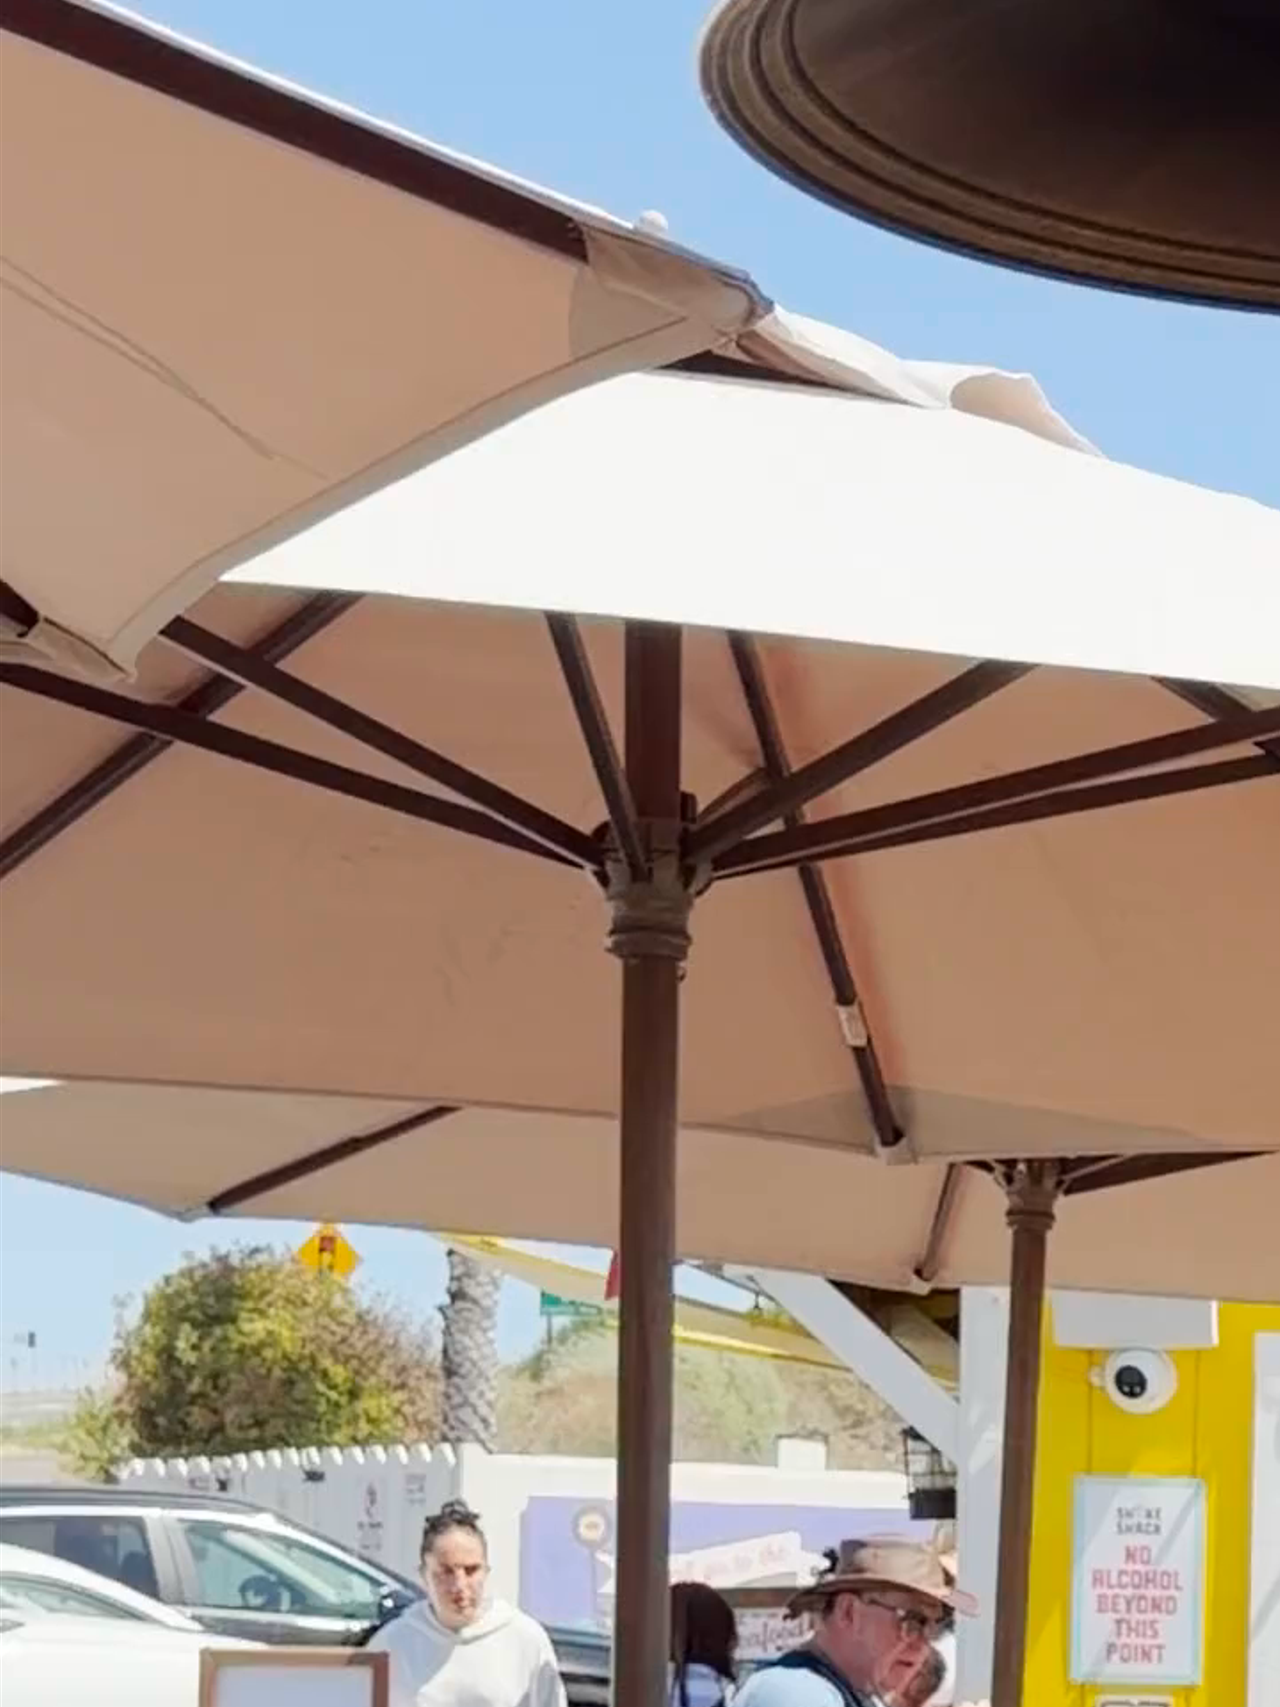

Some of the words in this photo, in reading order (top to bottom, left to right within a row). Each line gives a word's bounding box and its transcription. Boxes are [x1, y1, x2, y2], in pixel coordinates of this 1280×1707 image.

[1125, 1545, 1152, 1565] NO
[1091, 1569, 1183, 1591] ALCOHOL
[1096, 1594, 1178, 1615] BEYOND
[1115, 1618, 1160, 1639] THIS
[1106, 1642, 1166, 1664] POINT
